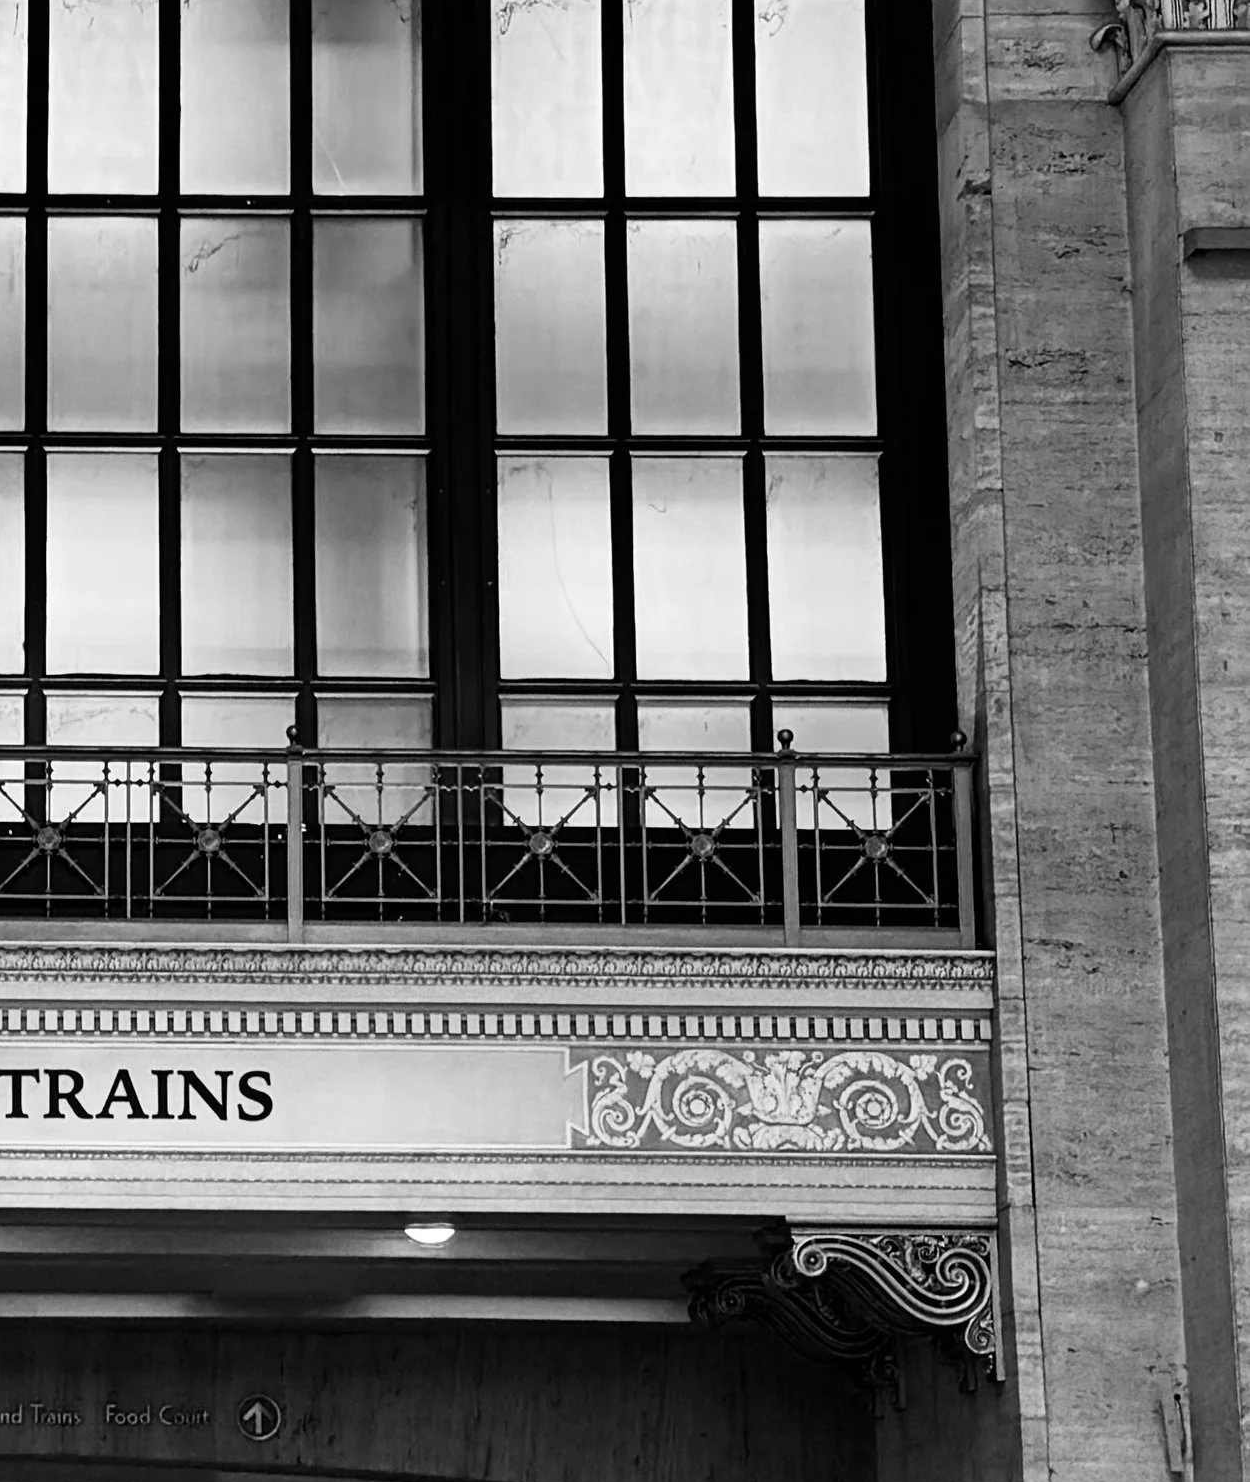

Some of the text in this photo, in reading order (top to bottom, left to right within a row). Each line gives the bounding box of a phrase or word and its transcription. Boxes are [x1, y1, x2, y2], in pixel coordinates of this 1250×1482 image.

[29, 1403, 82, 1425] Trains
[106, 1404, 210, 1425] Food Court
